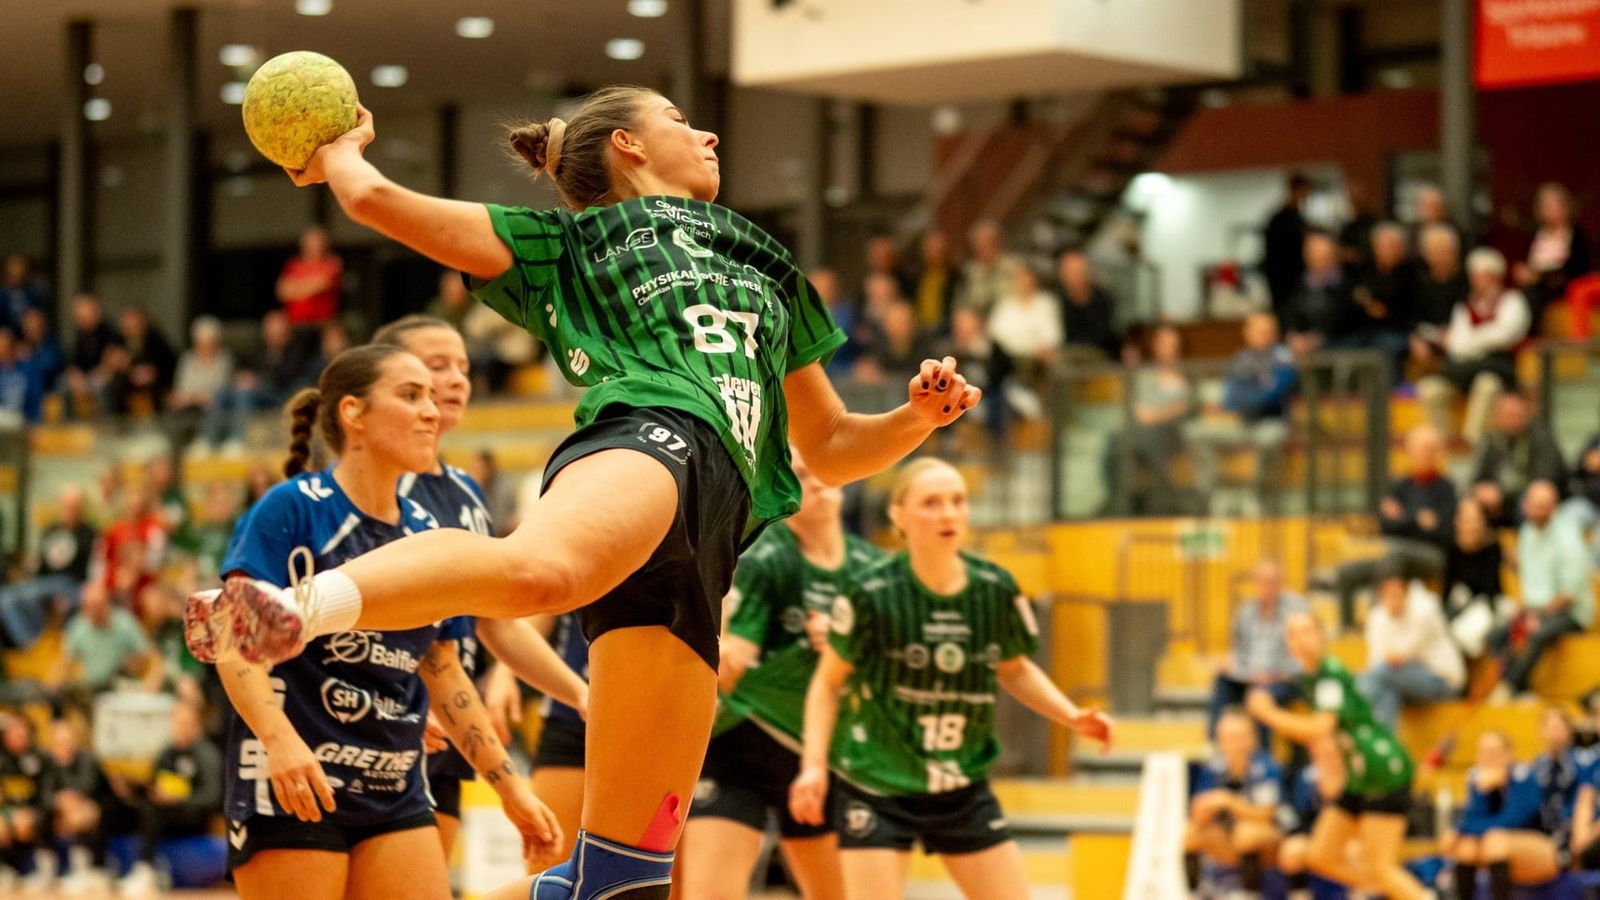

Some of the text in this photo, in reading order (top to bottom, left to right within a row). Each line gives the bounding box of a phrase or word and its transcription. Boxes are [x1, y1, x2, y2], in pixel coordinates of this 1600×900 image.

[683, 304, 759, 360] 87
[648, 427, 688, 451] 97
[332, 688, 359, 709] SH
[918, 714, 967, 751] 18
